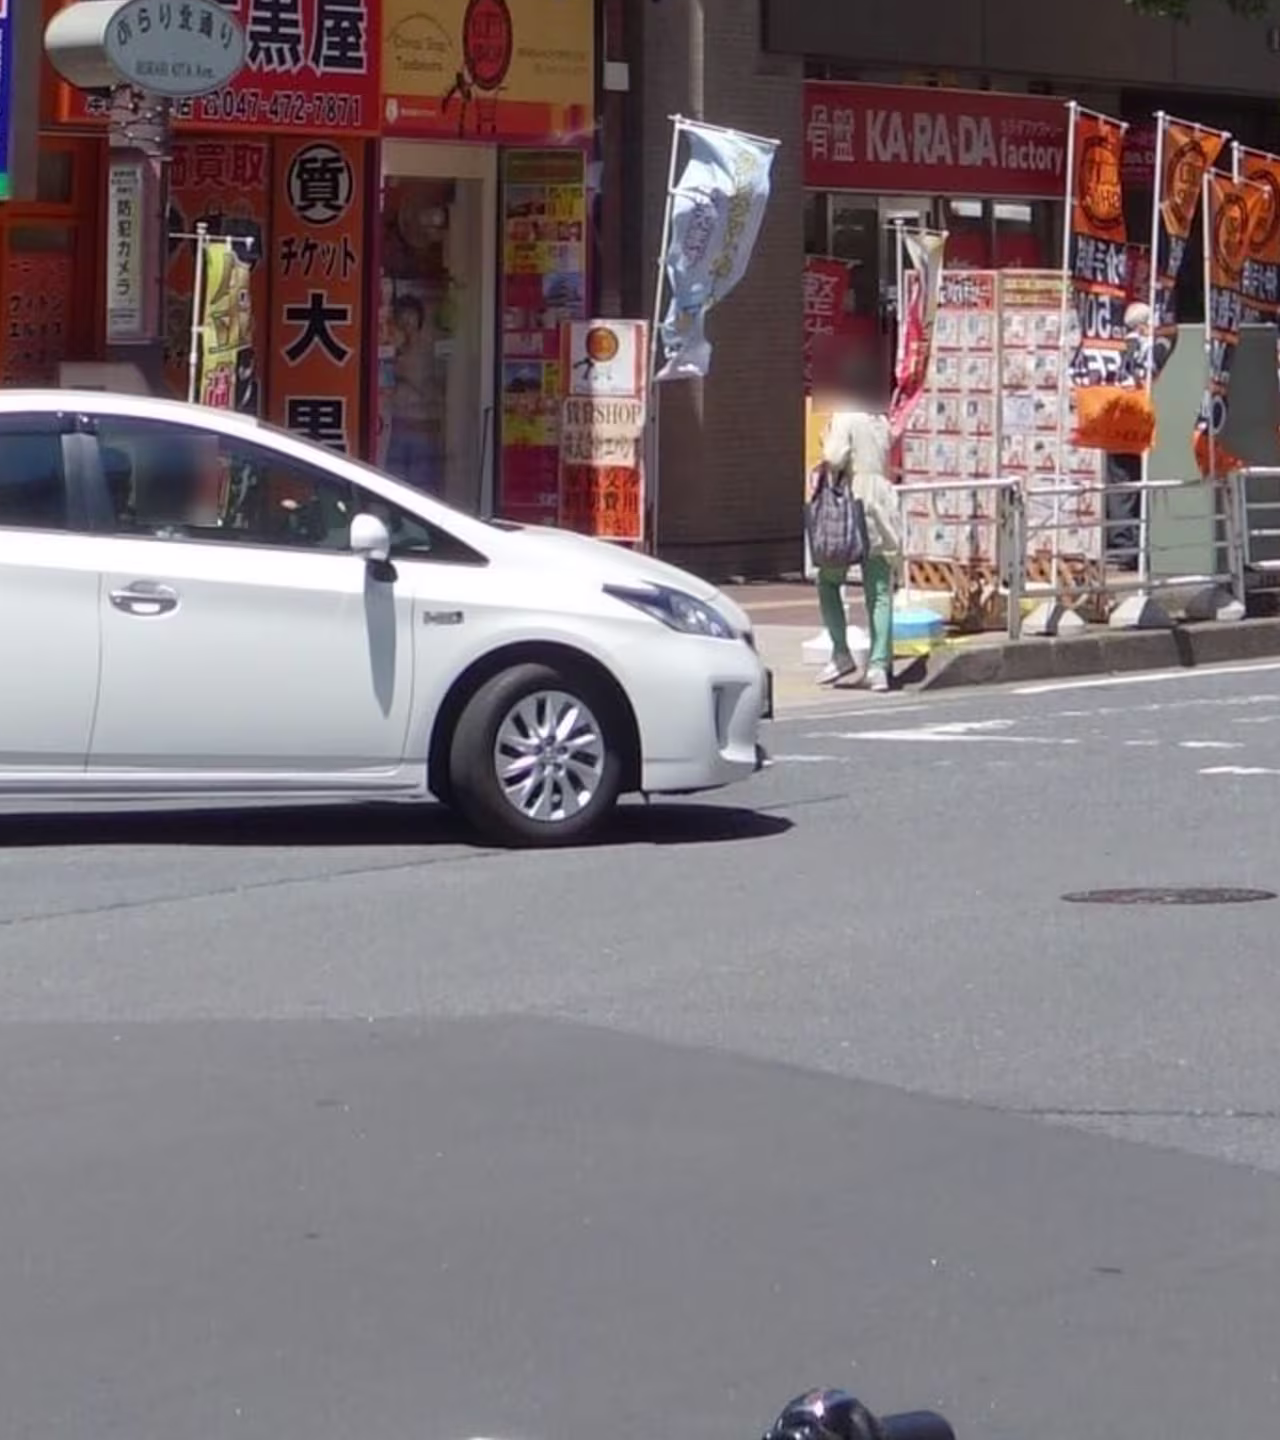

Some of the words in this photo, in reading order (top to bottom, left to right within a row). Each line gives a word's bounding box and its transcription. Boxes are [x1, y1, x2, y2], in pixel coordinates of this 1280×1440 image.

[222, 88, 362, 127] 047-472-7871
[1000, 138, 1066, 176] factory
[295, 150, 347, 218] 質
[116, 199, 133, 297] 防犯カメラ
[279, 236, 356, 282] チケット
